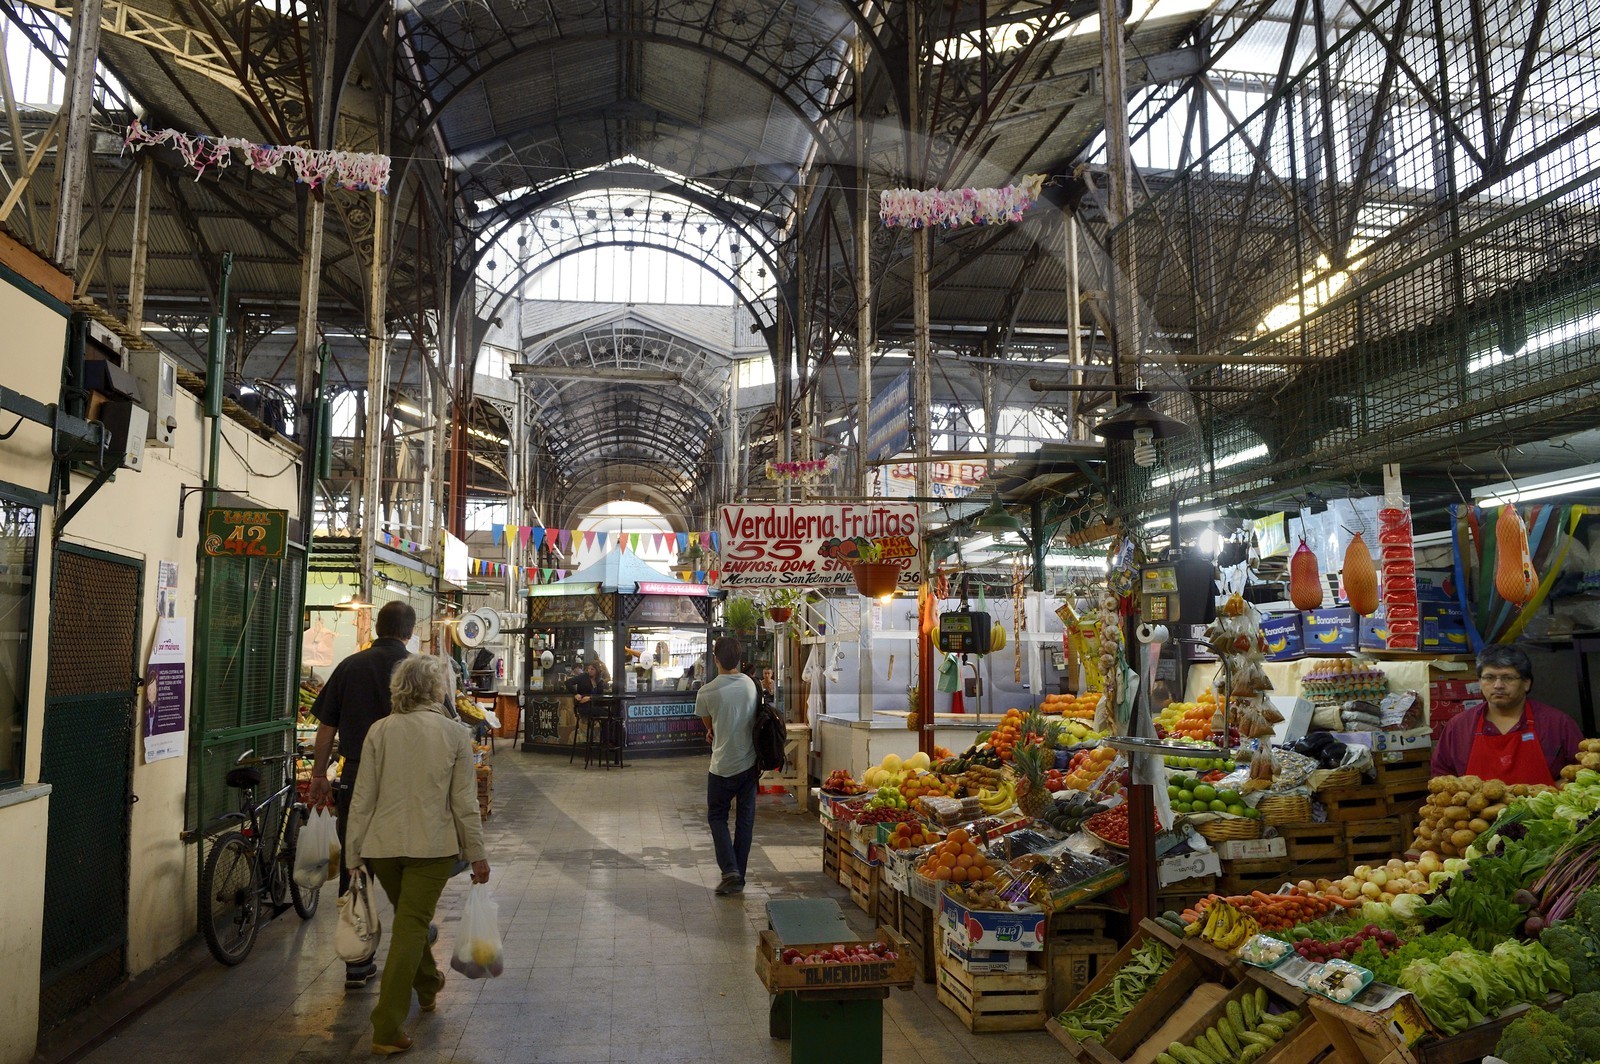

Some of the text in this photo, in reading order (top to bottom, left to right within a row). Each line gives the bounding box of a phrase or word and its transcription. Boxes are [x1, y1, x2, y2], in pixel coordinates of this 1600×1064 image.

[223, 510, 271, 525] LOCAL
[223, 525, 268, 556] 42
[722, 560, 773, 573] ENVIOS
[779, 560, 816, 573] DOM.
[722, 573, 777, 584] Mercado
[633, 706, 653, 716] CAFES
[653, 705, 661, 715] DE
[995, 924, 1024, 943] Cervi
